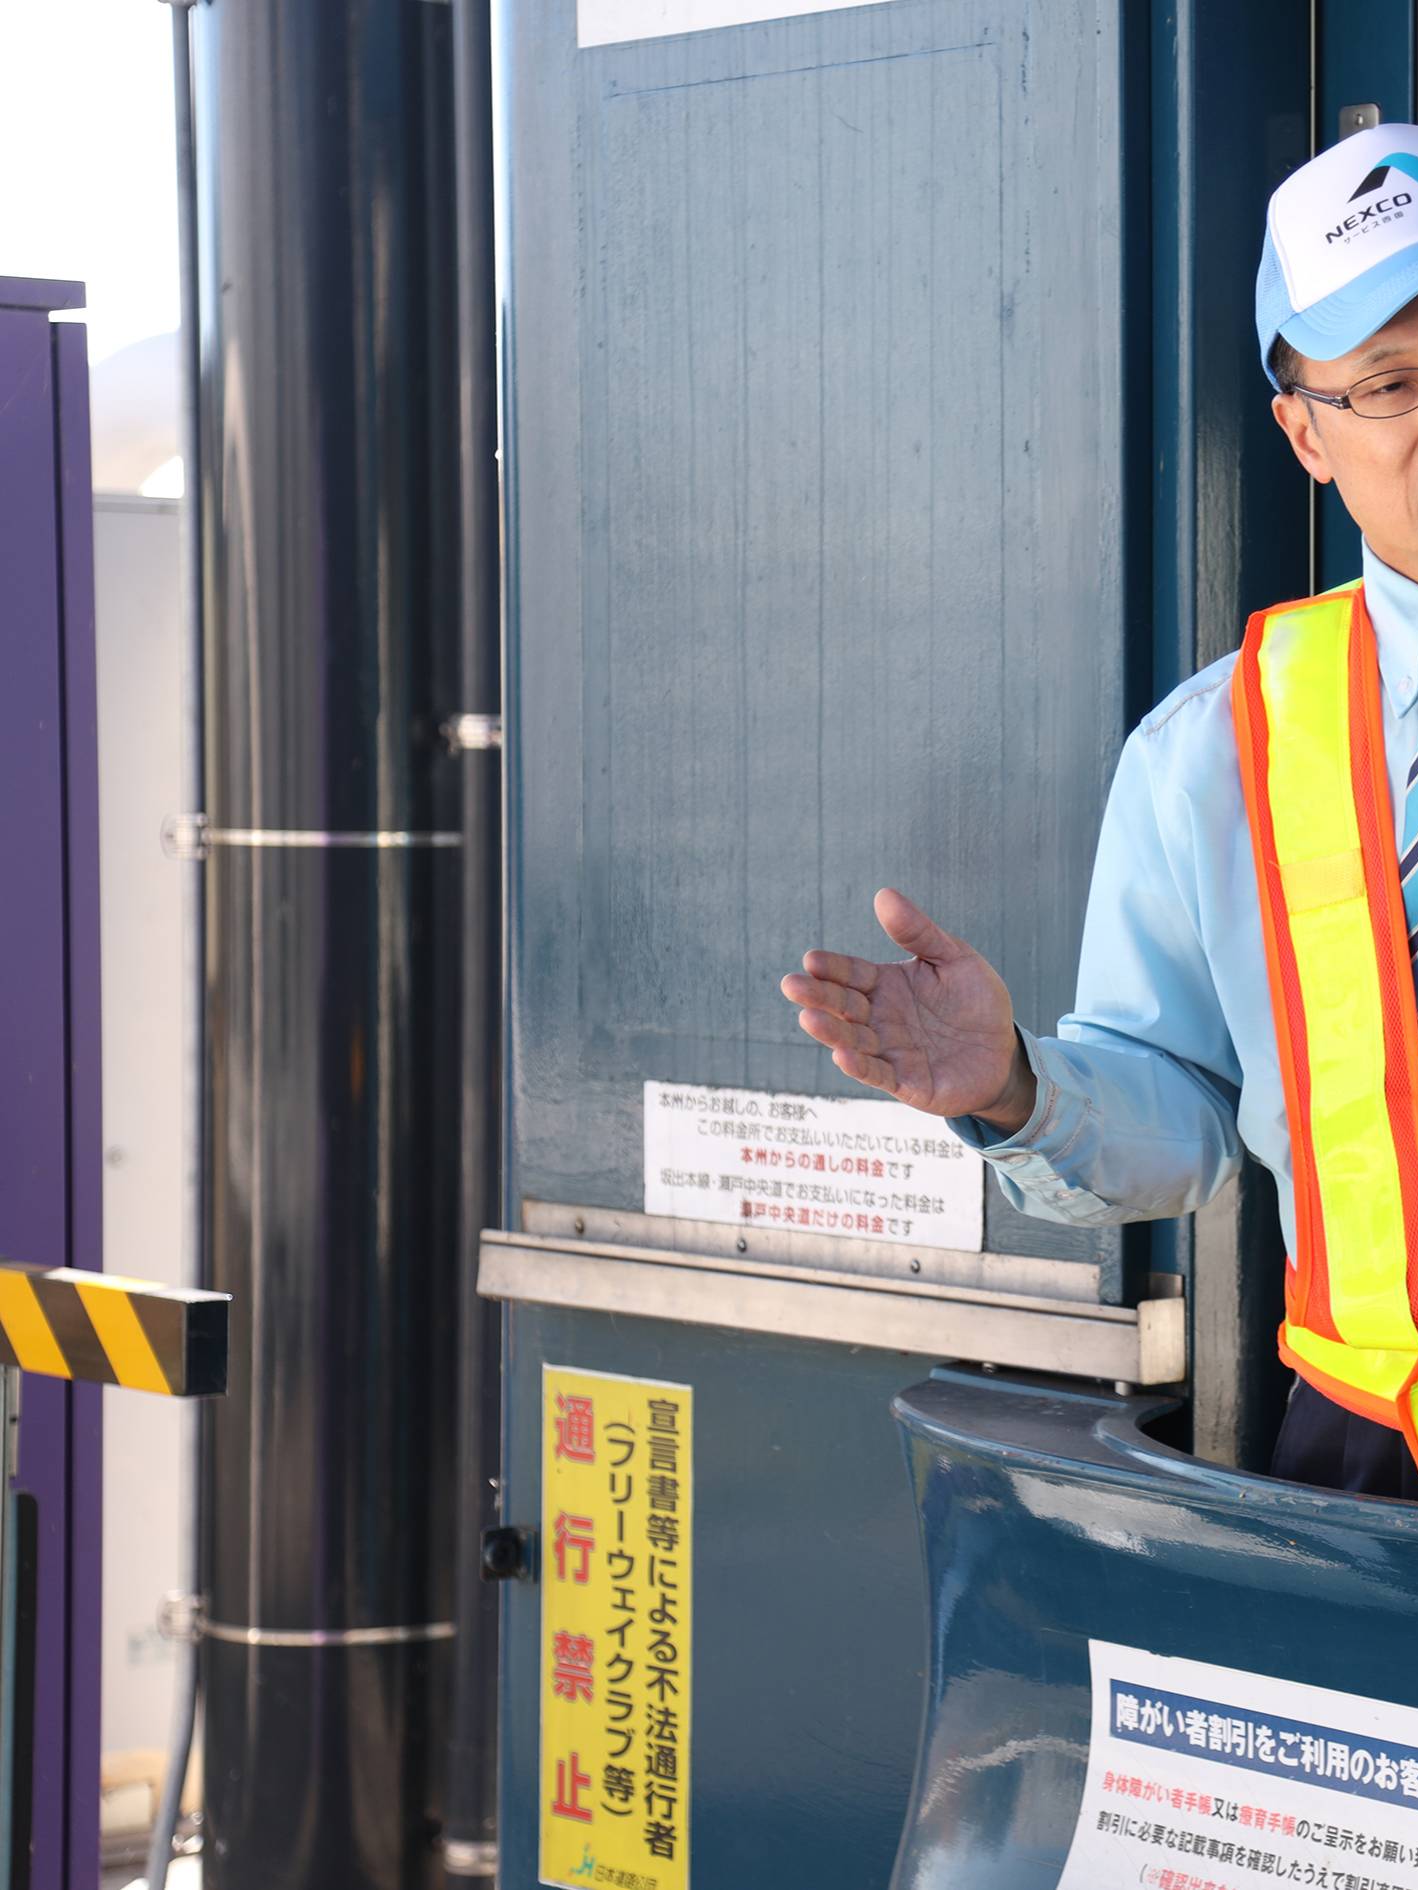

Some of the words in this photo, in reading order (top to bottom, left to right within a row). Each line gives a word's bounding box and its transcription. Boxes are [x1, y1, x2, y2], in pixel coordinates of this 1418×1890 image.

[1325, 193, 1412, 244] NEXCO
[553, 1394, 595, 1823] 通行禁止
[645, 1399, 679, 1860] 宣言書等による不法通行者
[1096, 1810, 1412, 1890] 割引に必要な記載事項を確認したうえで割引
